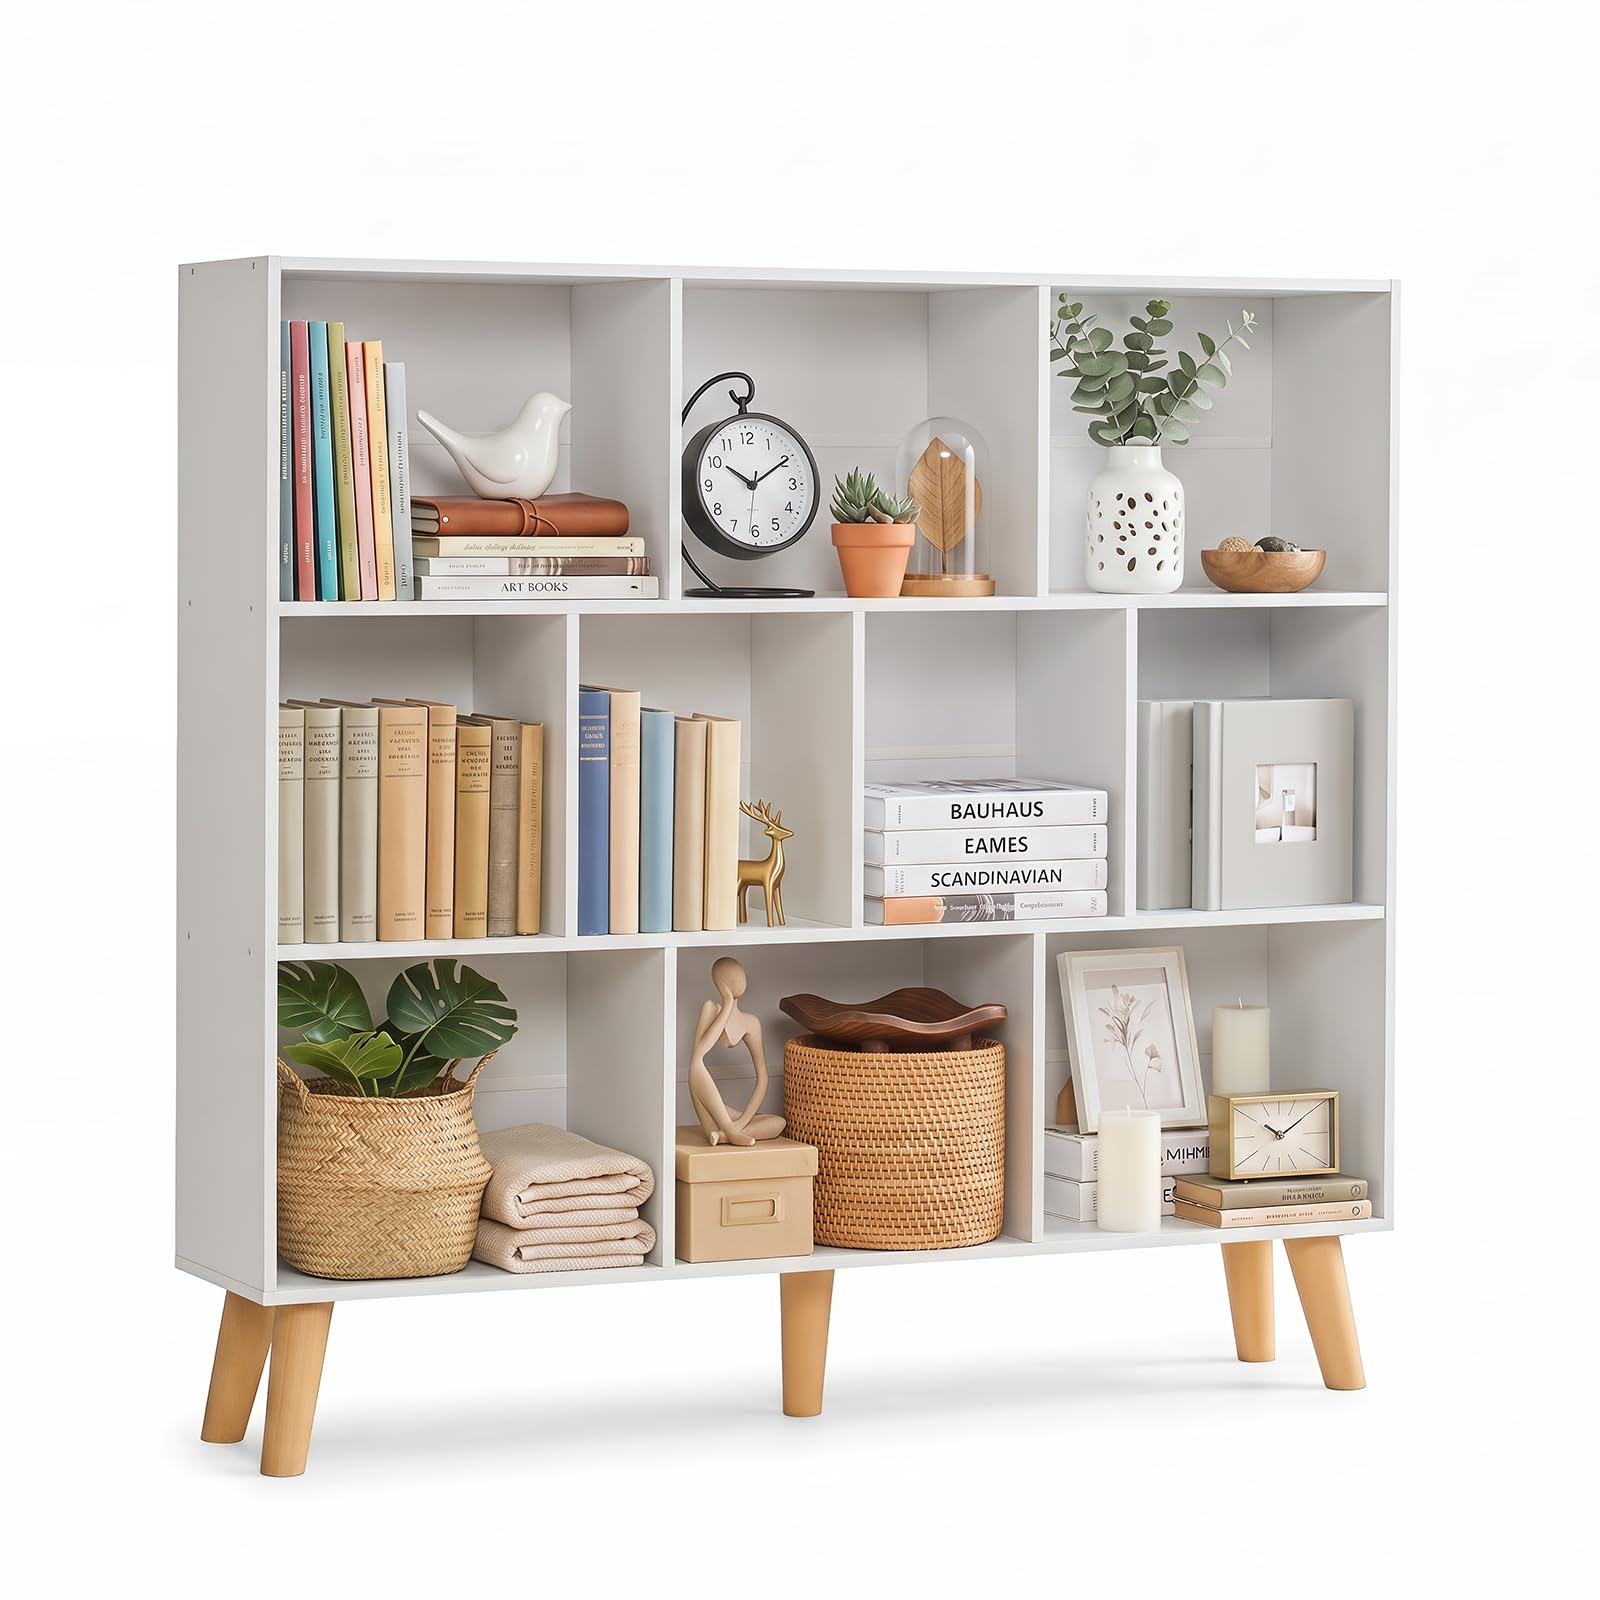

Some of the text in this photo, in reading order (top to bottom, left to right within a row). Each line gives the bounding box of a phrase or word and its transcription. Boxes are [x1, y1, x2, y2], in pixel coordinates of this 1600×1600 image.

[721, 438, 732, 451] 11
[740, 431, 754, 445] 12
[708, 455, 722, 468] 10
[780, 455, 789, 468] 2
[704, 479, 713, 492] 9
[788, 477, 798, 491] 3
[713, 502, 722, 516] 8
[784, 501, 793, 514] 4
[730, 519, 738, 532] 7
[771, 517, 780, 531] 5
[751, 525, 760, 538] 6
[501, 582, 568, 592] ART BOOKS
[950, 801, 1044, 820] BAUHAUS
[965, 836, 1028, 854] EAMES
[930, 868, 1063, 888] SCANDINAVIAN
